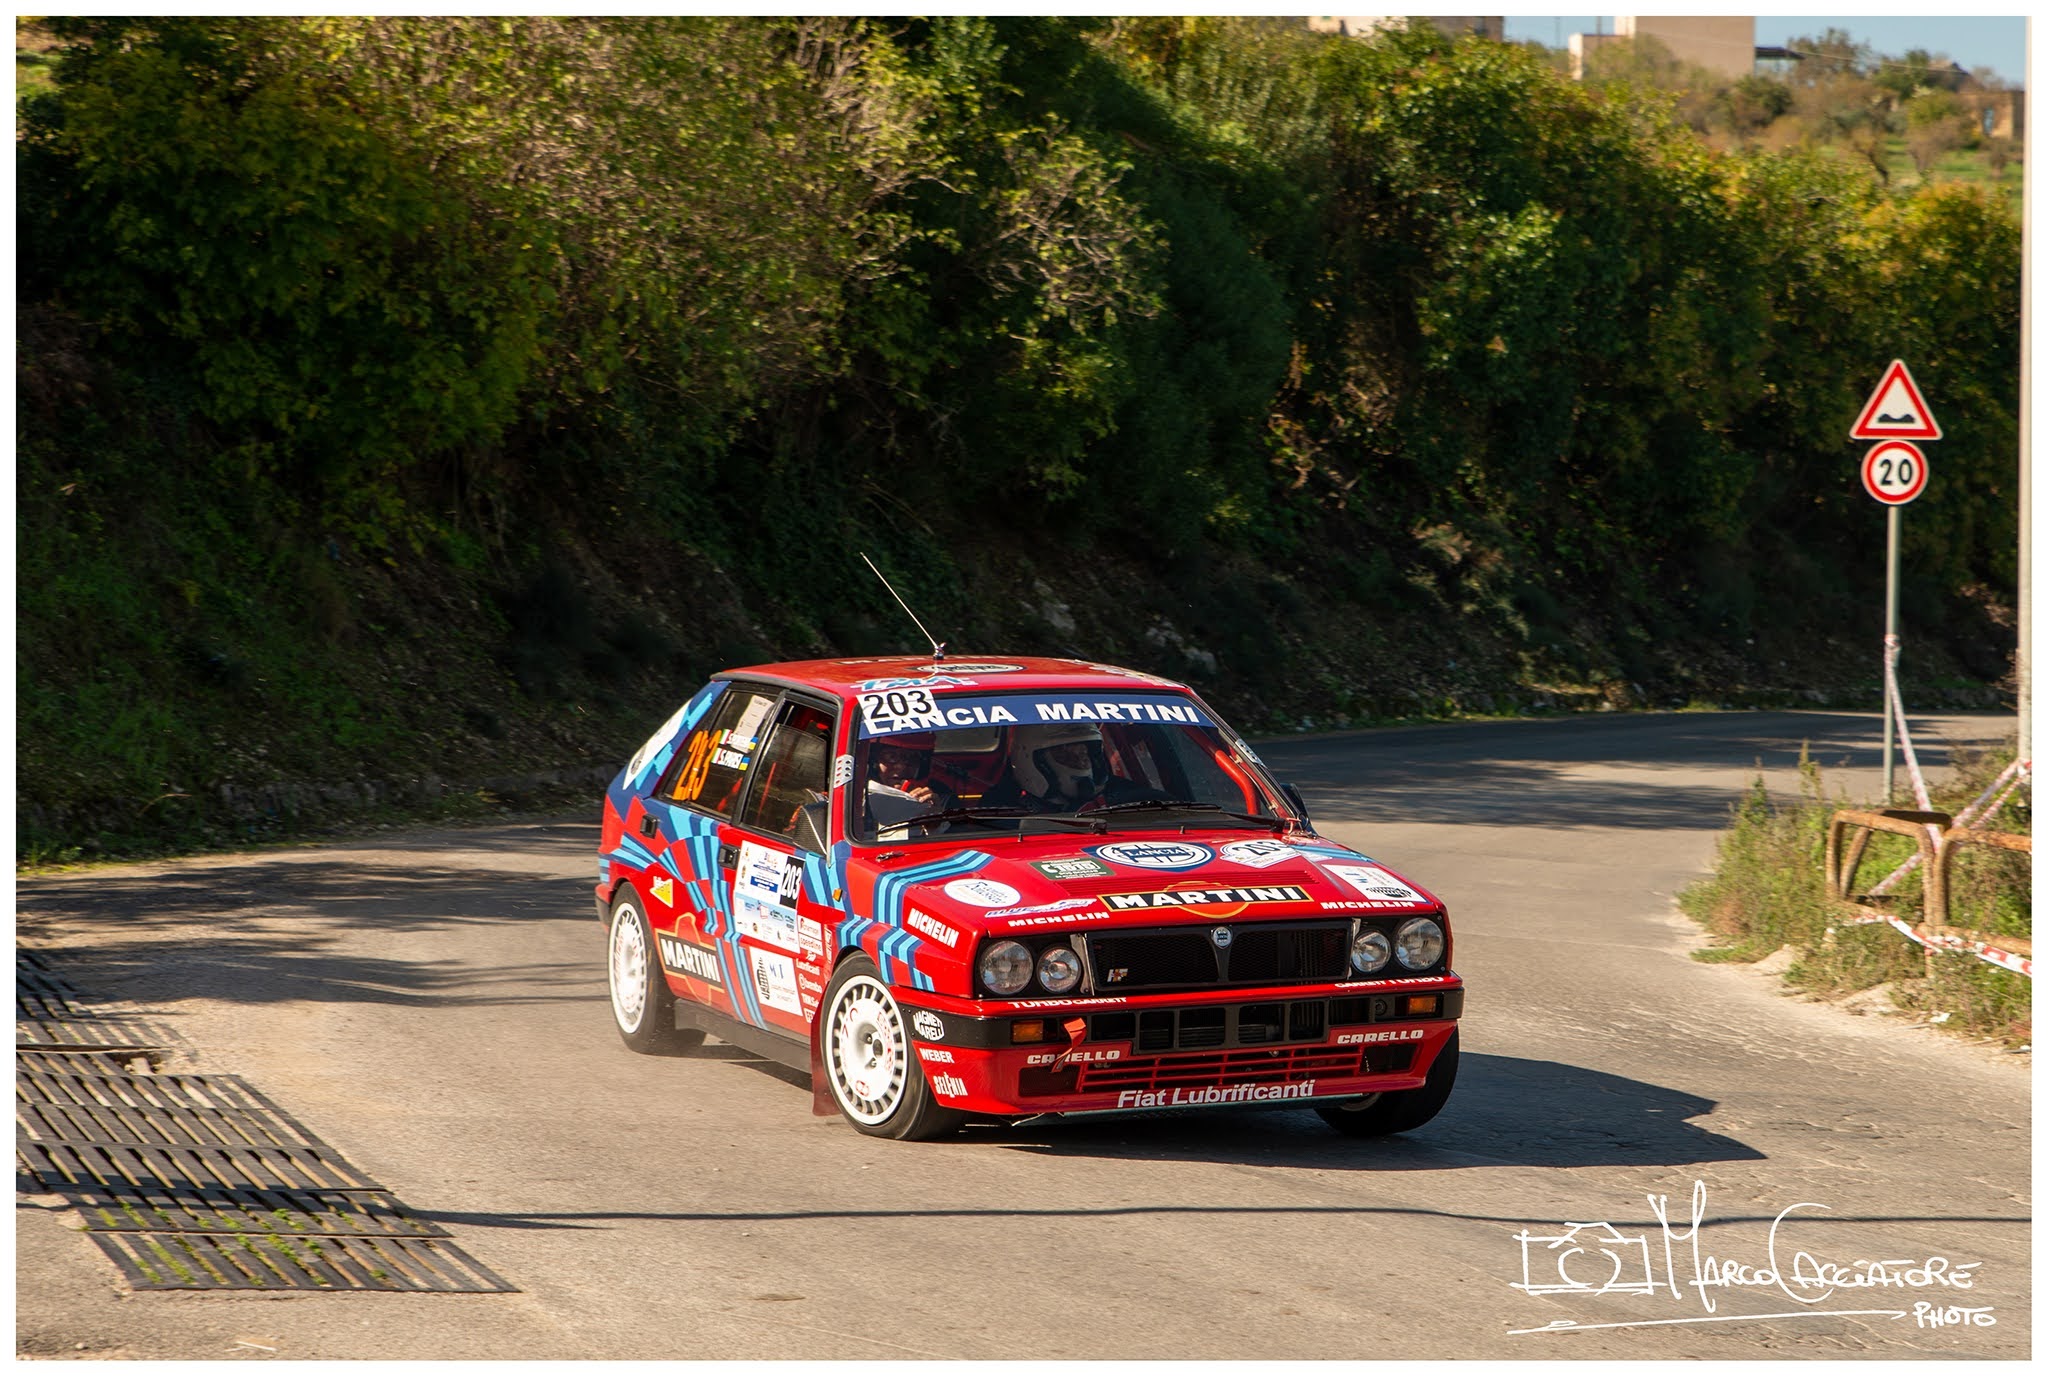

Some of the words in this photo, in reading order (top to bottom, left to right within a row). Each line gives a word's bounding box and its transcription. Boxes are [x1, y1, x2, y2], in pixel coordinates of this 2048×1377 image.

[1880, 458, 1913, 486] 20
[863, 690, 932, 719] 203
[863, 704, 1018, 735] LANCIA
[1036, 703, 1200, 724] MARTINI
[1126, 848, 1184, 857] LANCIA
[780, 864, 803, 900] 203
[1109, 886, 1305, 911] MARTINI
[1321, 900, 1415, 910] MICHELIN
[906, 908, 960, 948] MICHELIN
[1007, 911, 1110, 927] MICHELIN
[660, 938, 722, 983] MARTINI
[1337, 1029, 1424, 1045] CARELLO
[919, 1047, 955, 1064] WEBER
[1117, 1087, 1167, 1109] Fiat
[1171, 1079, 1315, 1105] Lubrificanti
